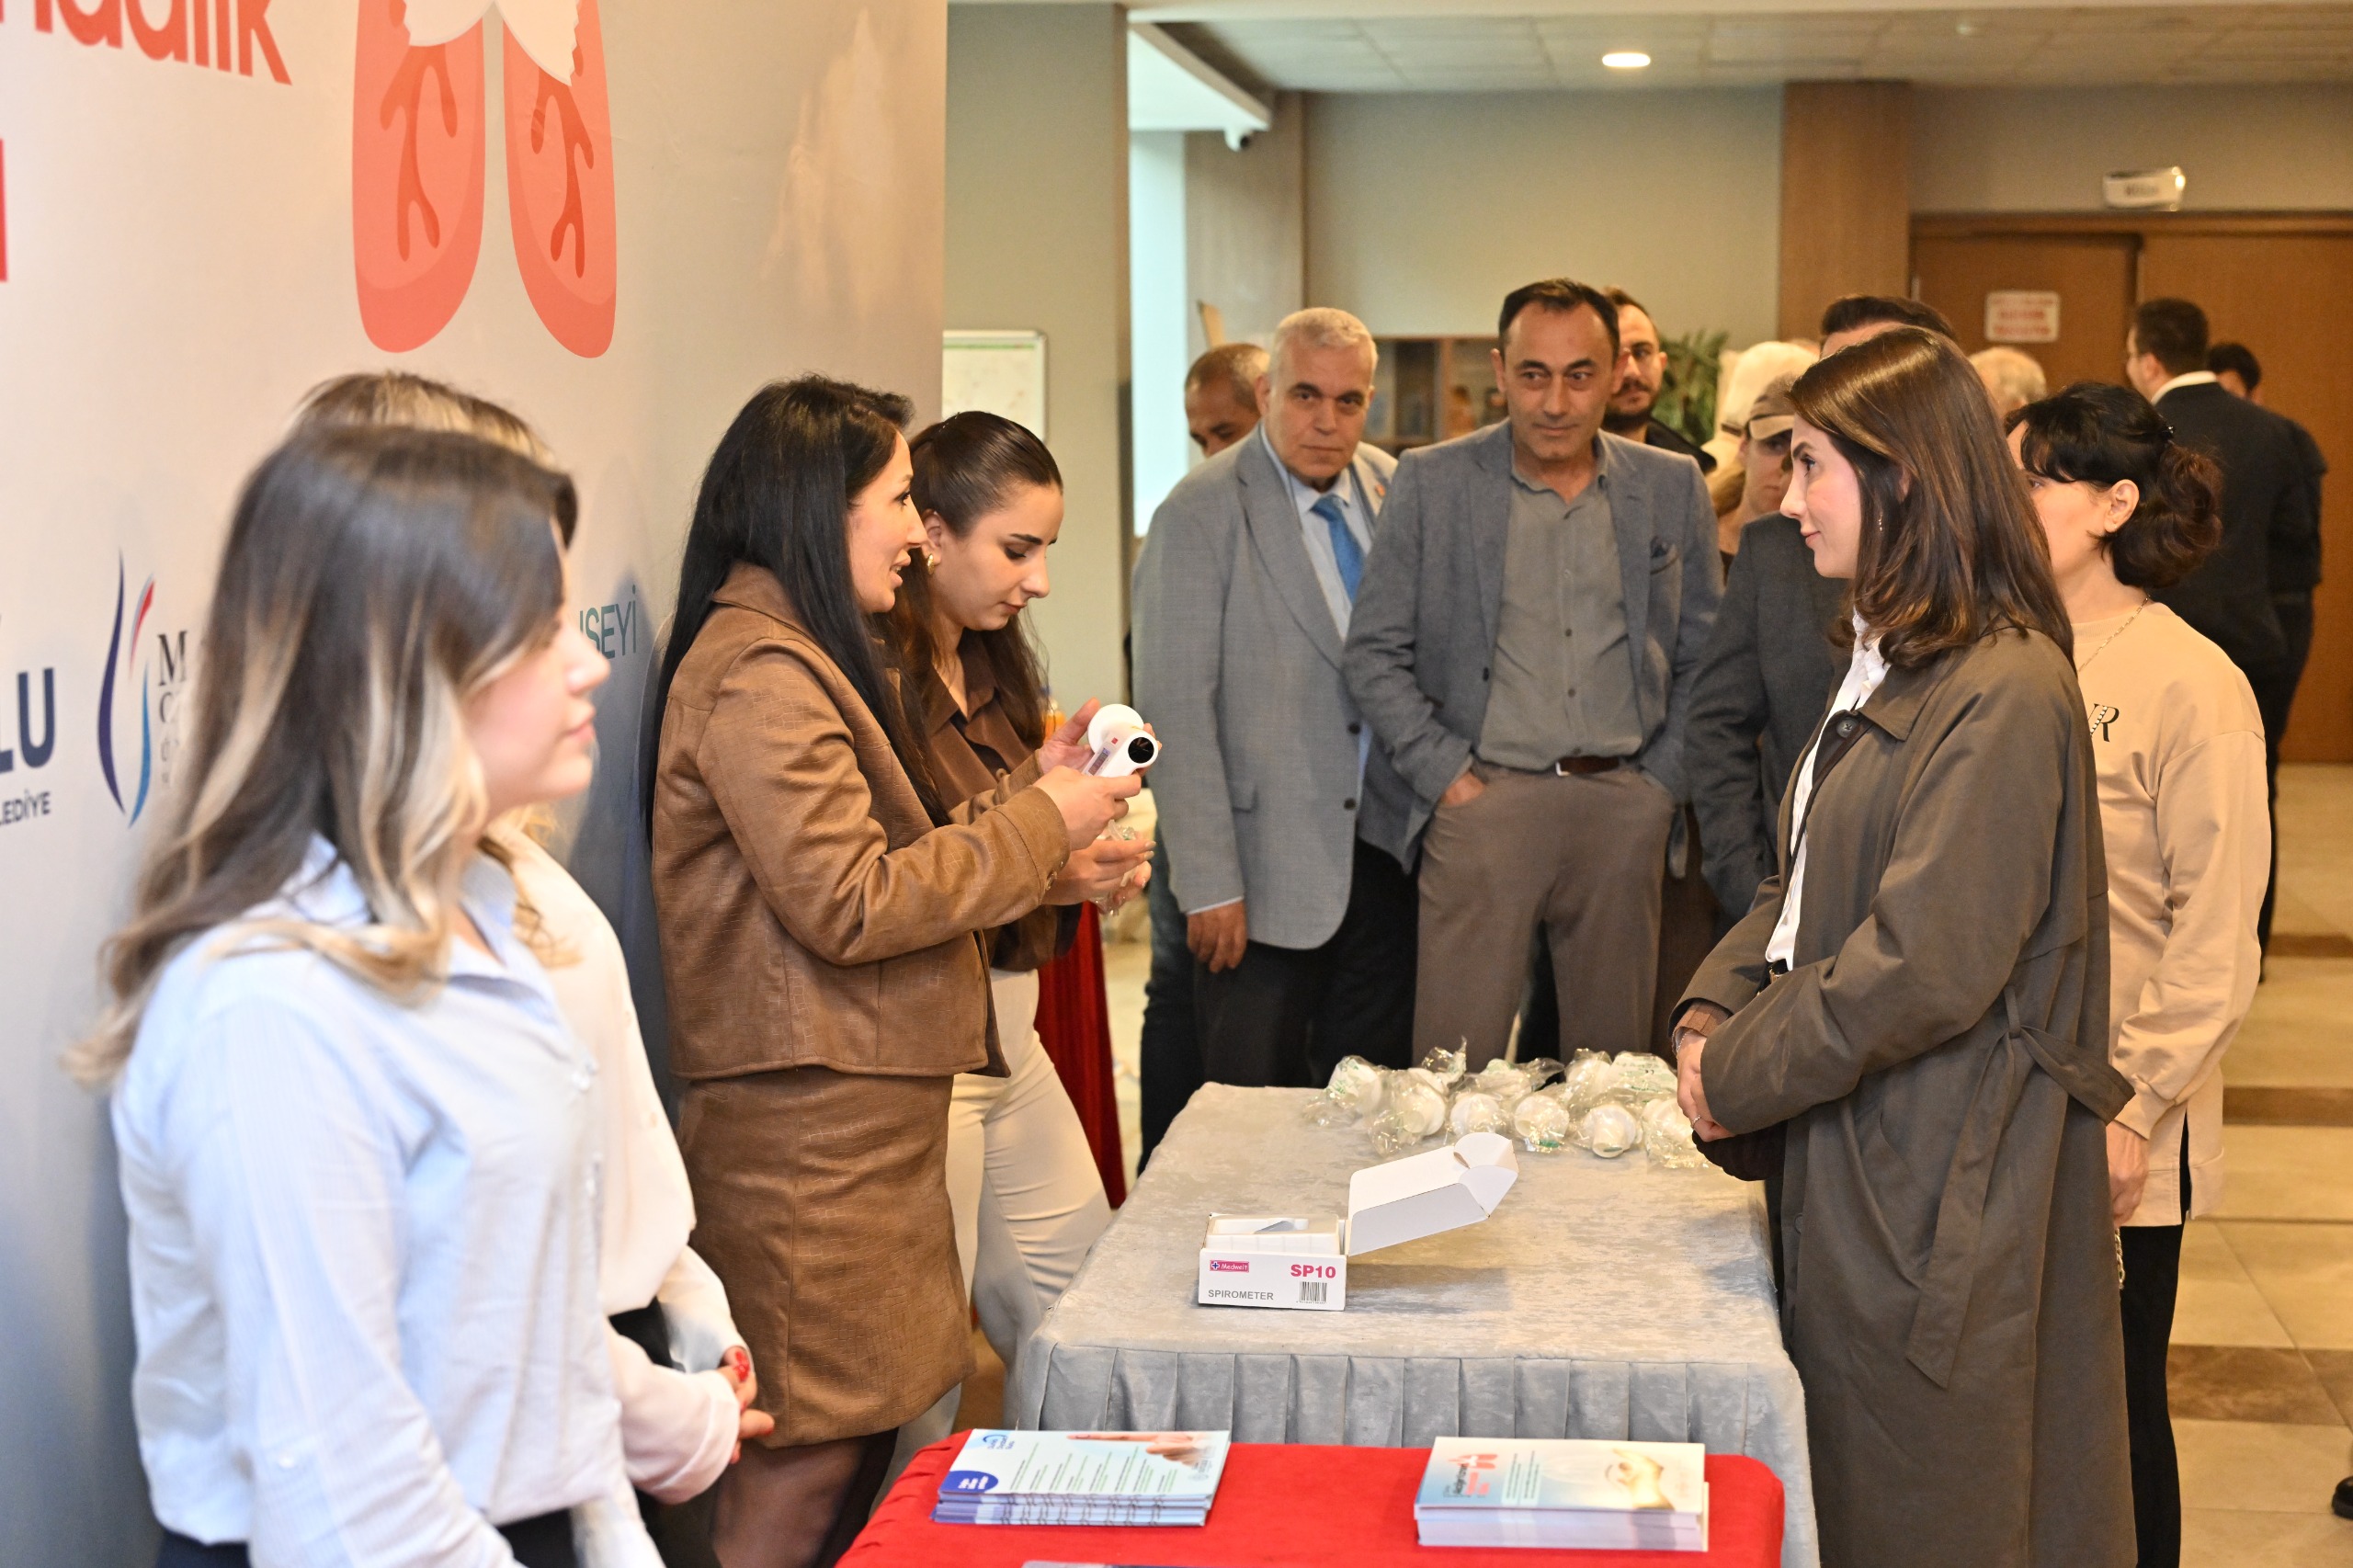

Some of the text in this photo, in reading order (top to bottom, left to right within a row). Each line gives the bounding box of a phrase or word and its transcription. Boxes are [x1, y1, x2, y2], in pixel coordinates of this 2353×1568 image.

[0, 789, 51, 825] EDİYE
[1290, 1264, 1336, 1278] SP10
[1208, 1289, 1274, 1301] SPIROMETER
